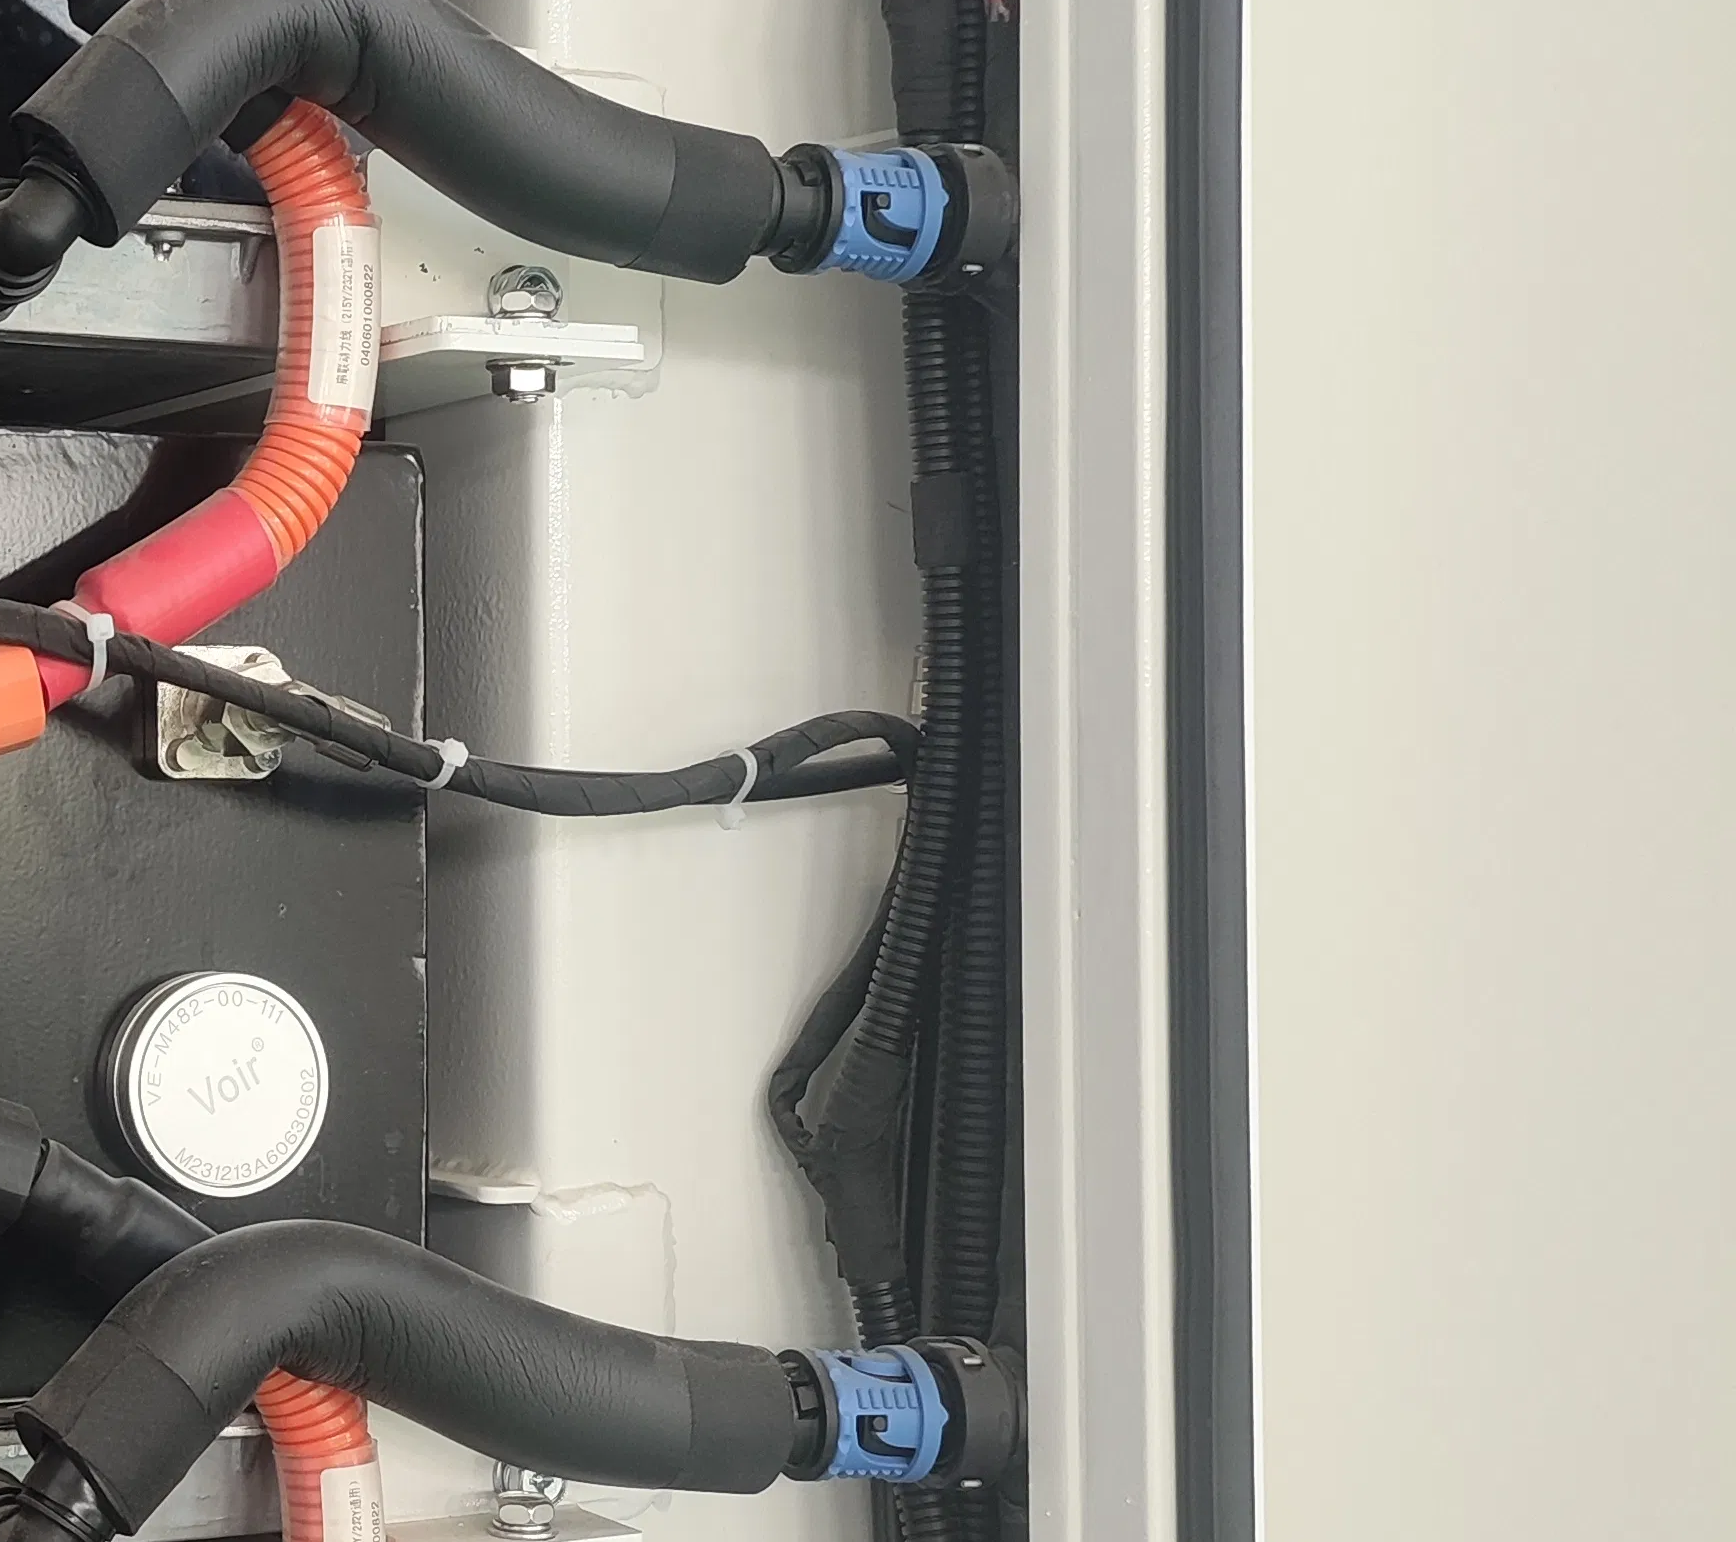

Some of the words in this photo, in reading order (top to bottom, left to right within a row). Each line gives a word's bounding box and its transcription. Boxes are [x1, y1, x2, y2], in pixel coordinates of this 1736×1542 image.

[360, 264, 374, 366] 040601000822
[147, 989, 284, 1107] VE-M482-00-111
[174, 1066, 315, 1181] M231213A60630602
